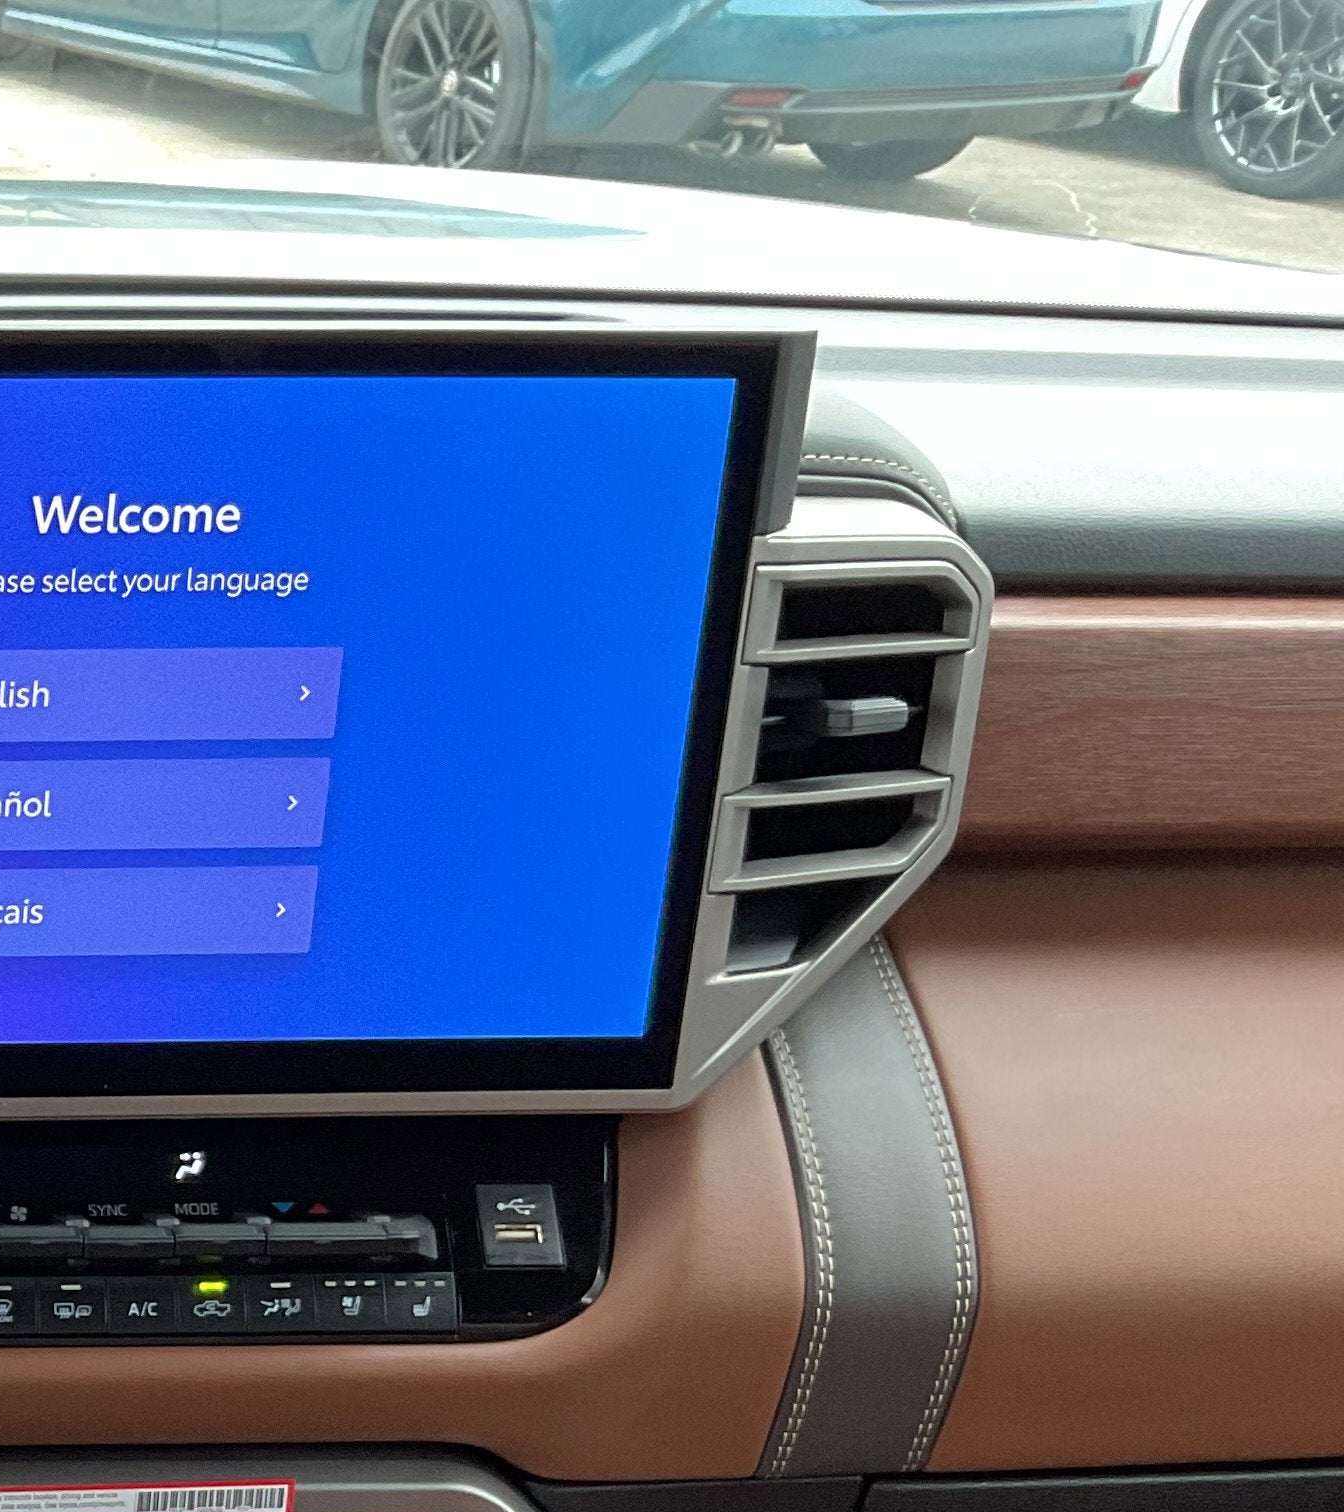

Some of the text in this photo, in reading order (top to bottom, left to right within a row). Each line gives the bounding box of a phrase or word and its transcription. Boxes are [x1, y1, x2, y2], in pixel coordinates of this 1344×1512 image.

[32, 493, 242, 535] Welcome
[41, 567, 118, 594] select
[121, 573, 182, 599] your
[187, 567, 310, 598] language
[88, 1204, 128, 1218] SYNC
[174, 1202, 219, 1217] MODE
[128, 1302, 158, 1317] A/C
